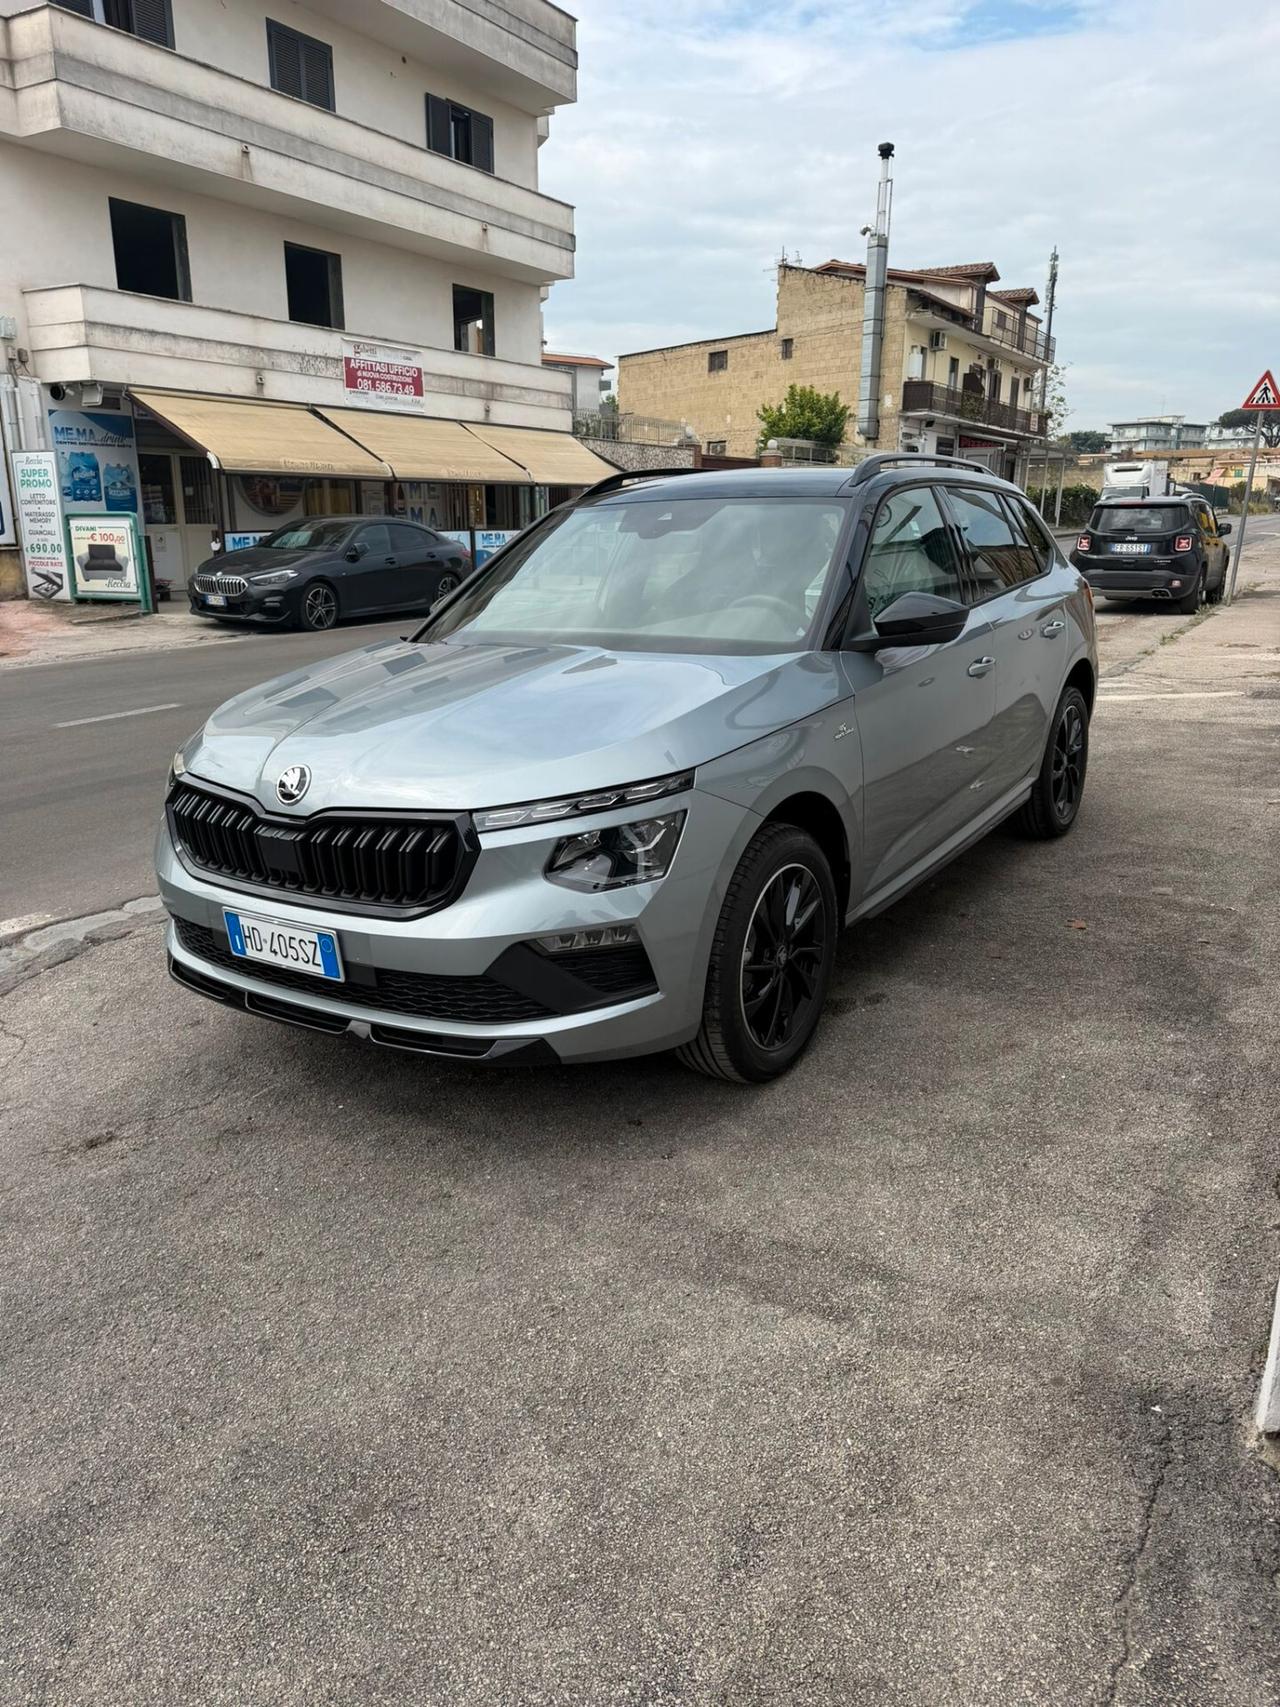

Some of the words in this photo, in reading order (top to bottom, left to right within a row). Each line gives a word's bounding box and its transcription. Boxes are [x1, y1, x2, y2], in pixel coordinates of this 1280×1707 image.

[350, 359, 387, 375] AFFITTASI
[389, 365, 418, 377] UFFICIO
[362, 371, 380, 379] NUOVA
[380, 373, 413, 383] COSTRUZIONE
[20, 468, 48, 478] SUPER
[20, 479, 52, 488] PROMO
[90, 532, 97, 542] €
